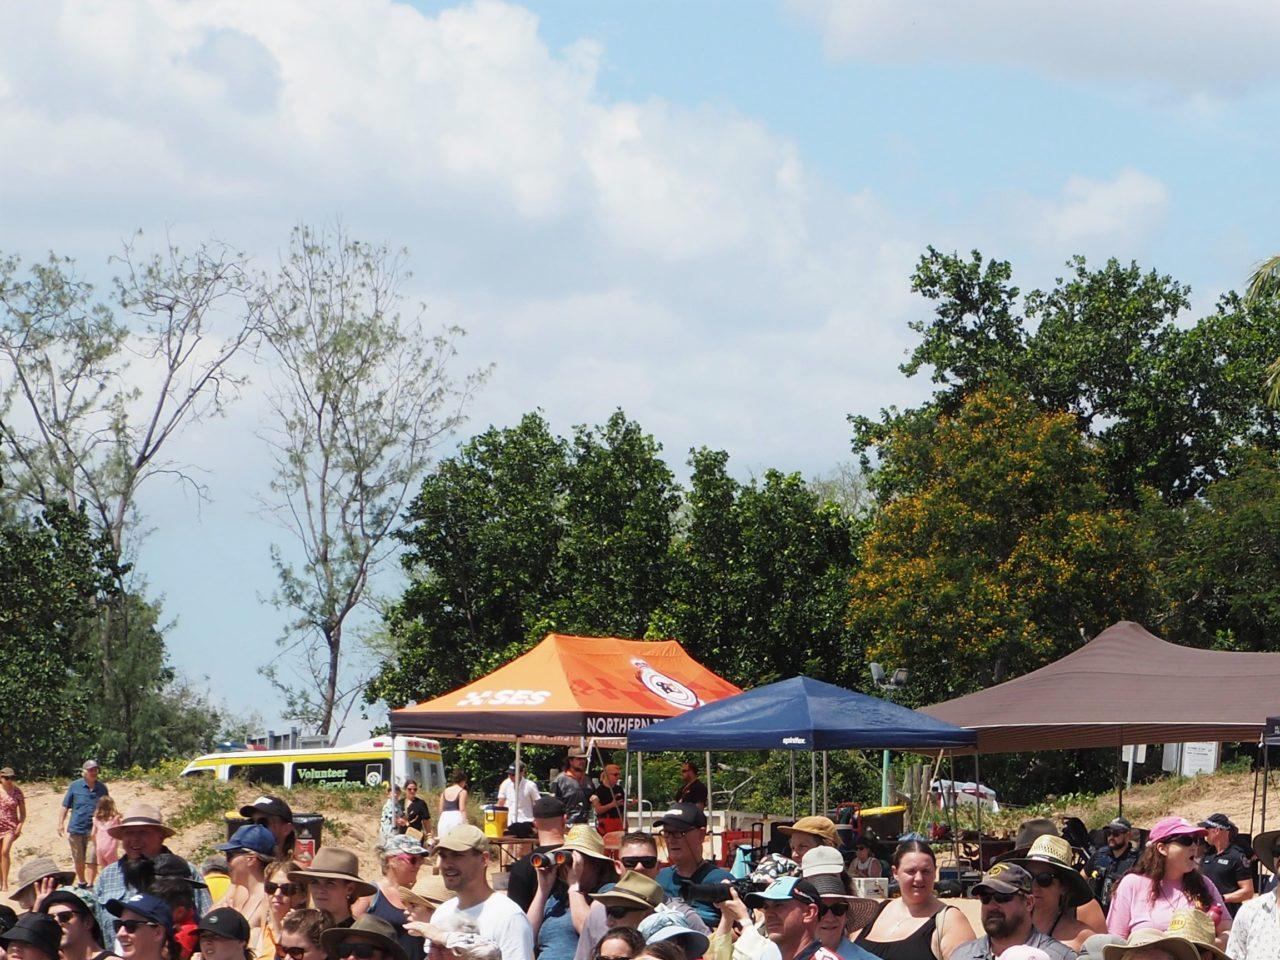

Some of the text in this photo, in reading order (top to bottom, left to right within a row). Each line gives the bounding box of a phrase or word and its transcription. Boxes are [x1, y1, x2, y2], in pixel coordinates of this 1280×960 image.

[488, 689, 552, 706] SES
[586, 717, 650, 734] NORTHERN
[297, 767, 348, 779] Volunteer
